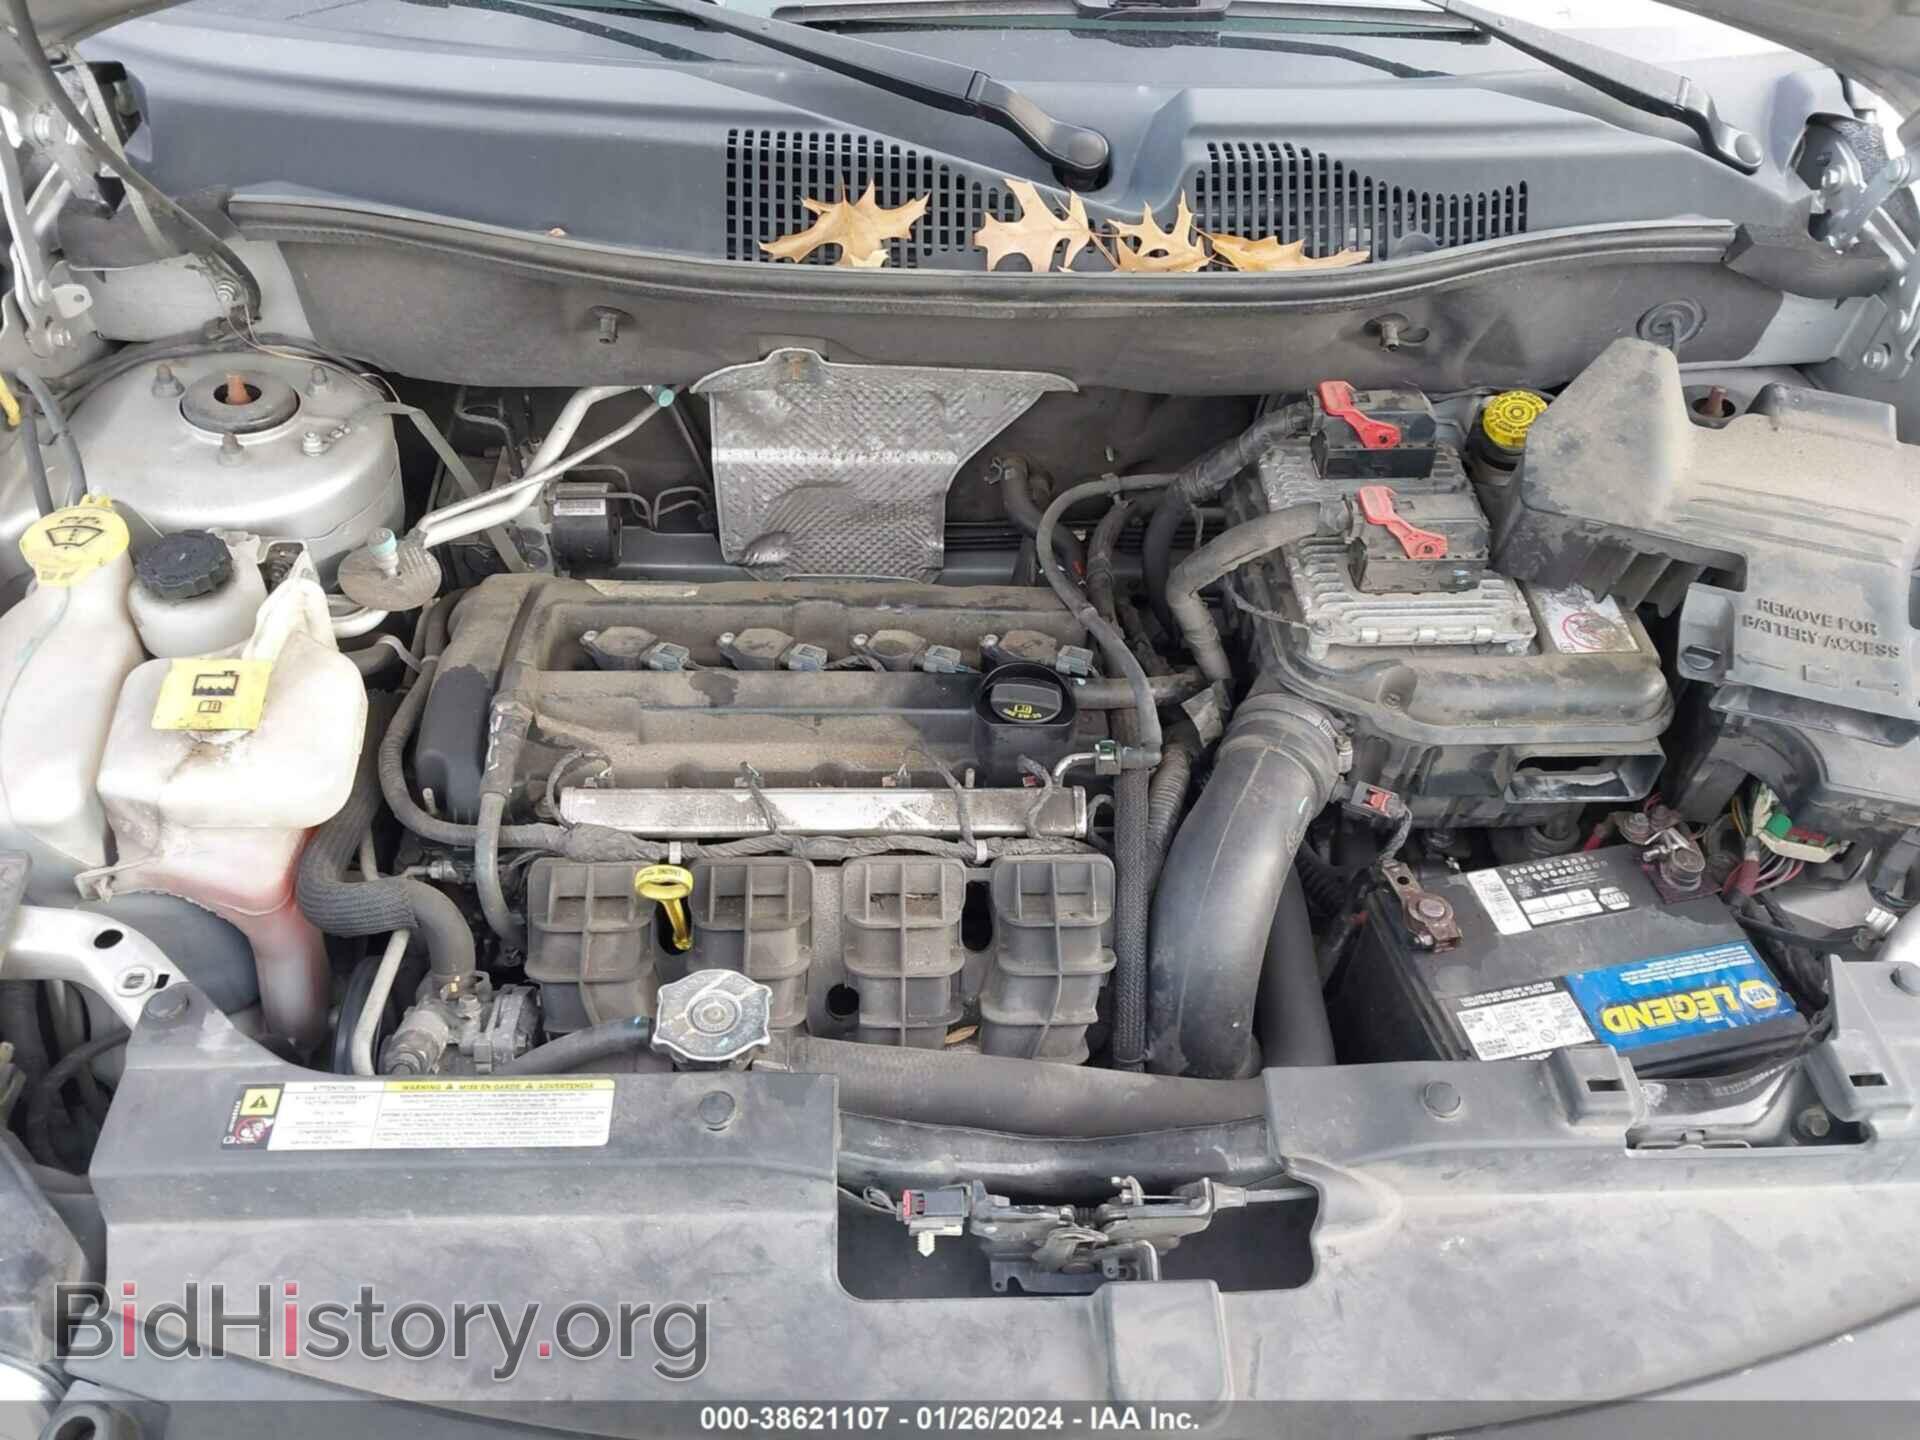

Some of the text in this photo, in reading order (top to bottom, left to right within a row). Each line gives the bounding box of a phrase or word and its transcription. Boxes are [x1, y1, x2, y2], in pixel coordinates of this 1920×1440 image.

[1741, 614, 1900, 658] BATTERY ACCESS
[1756, 598, 1878, 635] REMOVE FOR
[1602, 986, 1742, 1035] LEGEND
